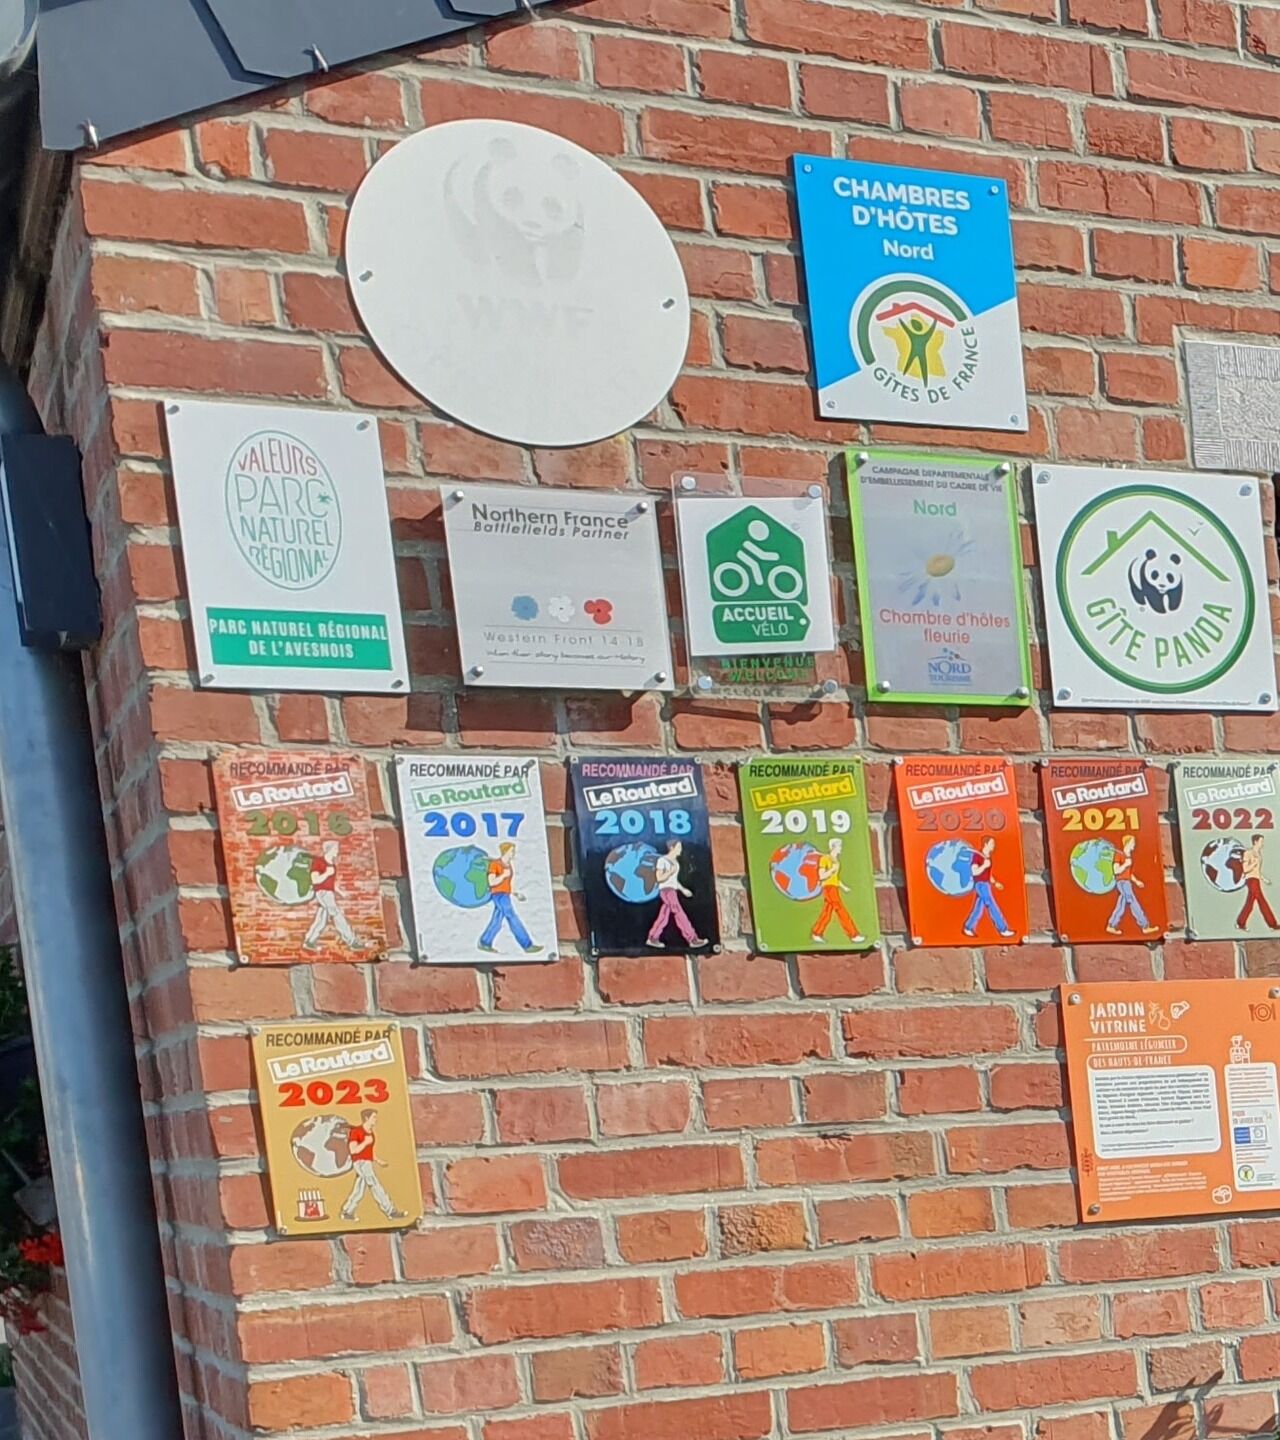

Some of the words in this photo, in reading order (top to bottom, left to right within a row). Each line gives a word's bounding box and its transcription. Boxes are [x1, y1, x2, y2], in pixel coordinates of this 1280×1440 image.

[833, 176, 971, 211] CHAMBRES
[852, 204, 959, 236] D'HÔTES
[883, 239, 935, 262] Nord
[873, 367, 921, 403] GÎTES
[927, 389, 951, 405] DE
[953, 326, 980, 391] FRANCE
[237, 438, 318, 477] VALEURS
[872, 466, 919, 477] CAMPAGNE
[234, 474, 328, 517] PARC
[936, 481, 948, 489] DU
[950, 482, 977, 491] CADRE
[979, 483, 990, 492] DE
[471, 503, 558, 525] Northern
[564, 511, 629, 530] France
[913, 499, 956, 517] Nord
[239, 516, 333, 548] NATUREL
[473, 521, 565, 538] Battlefields
[572, 528, 629, 541] Partner
[248, 544, 329, 583] RÉGIONAL
[722, 606, 795, 623] ACCUEIL
[879, 608, 951, 627] Chambre
[956, 613, 1010, 628] d'hôtes
[210, 618, 247, 635] PARC
[252, 621, 313, 638] NATUREL
[318, 622, 387, 641] RÉGIONAL
[751, 621, 788, 637] VÉLO
[923, 630, 970, 645] fleurie
[1085, 597, 1146, 661] GÎTE
[1154, 602, 1233, 668] PANDA
[484, 633, 546, 644] Western
[554, 634, 592, 645] Front
[249, 640, 267, 656] DE
[271, 641, 354, 659] L'AVESNOIS
[720, 655, 814, 669] BIENVENUE
[928, 661, 972, 674] NORD
[229, 762, 321, 777] RECOMMANDÉ
[409, 762, 501, 778] RECOMMANDÉ
[582, 762, 667, 778] RECOMMANDÉ
[749, 762, 830, 777] RECOMMANDÉ
[905, 762, 981, 776] RECOMMANDÉ
[1050, 764, 1123, 778] RECOMMANDÉ
[1182, 764, 1251, 778] RECOMMANDÉ
[245, 811, 352, 836] 2016
[423, 812, 525, 837] 2017
[594, 809, 692, 835] 2018
[760, 809, 851, 834] 2019
[917, 808, 1006, 832] 2020
[1062, 807, 1141, 832] 2021
[1191, 808, 1274, 830] 2022
[1089, 1002, 1145, 1020] JARDIN
[1090, 1019, 1146, 1034] VITRINE
[265, 1029, 361, 1048] RECOMMANDÉ
[1093, 1057, 1106, 1068] DES
[278, 1079, 390, 1108] 2023
